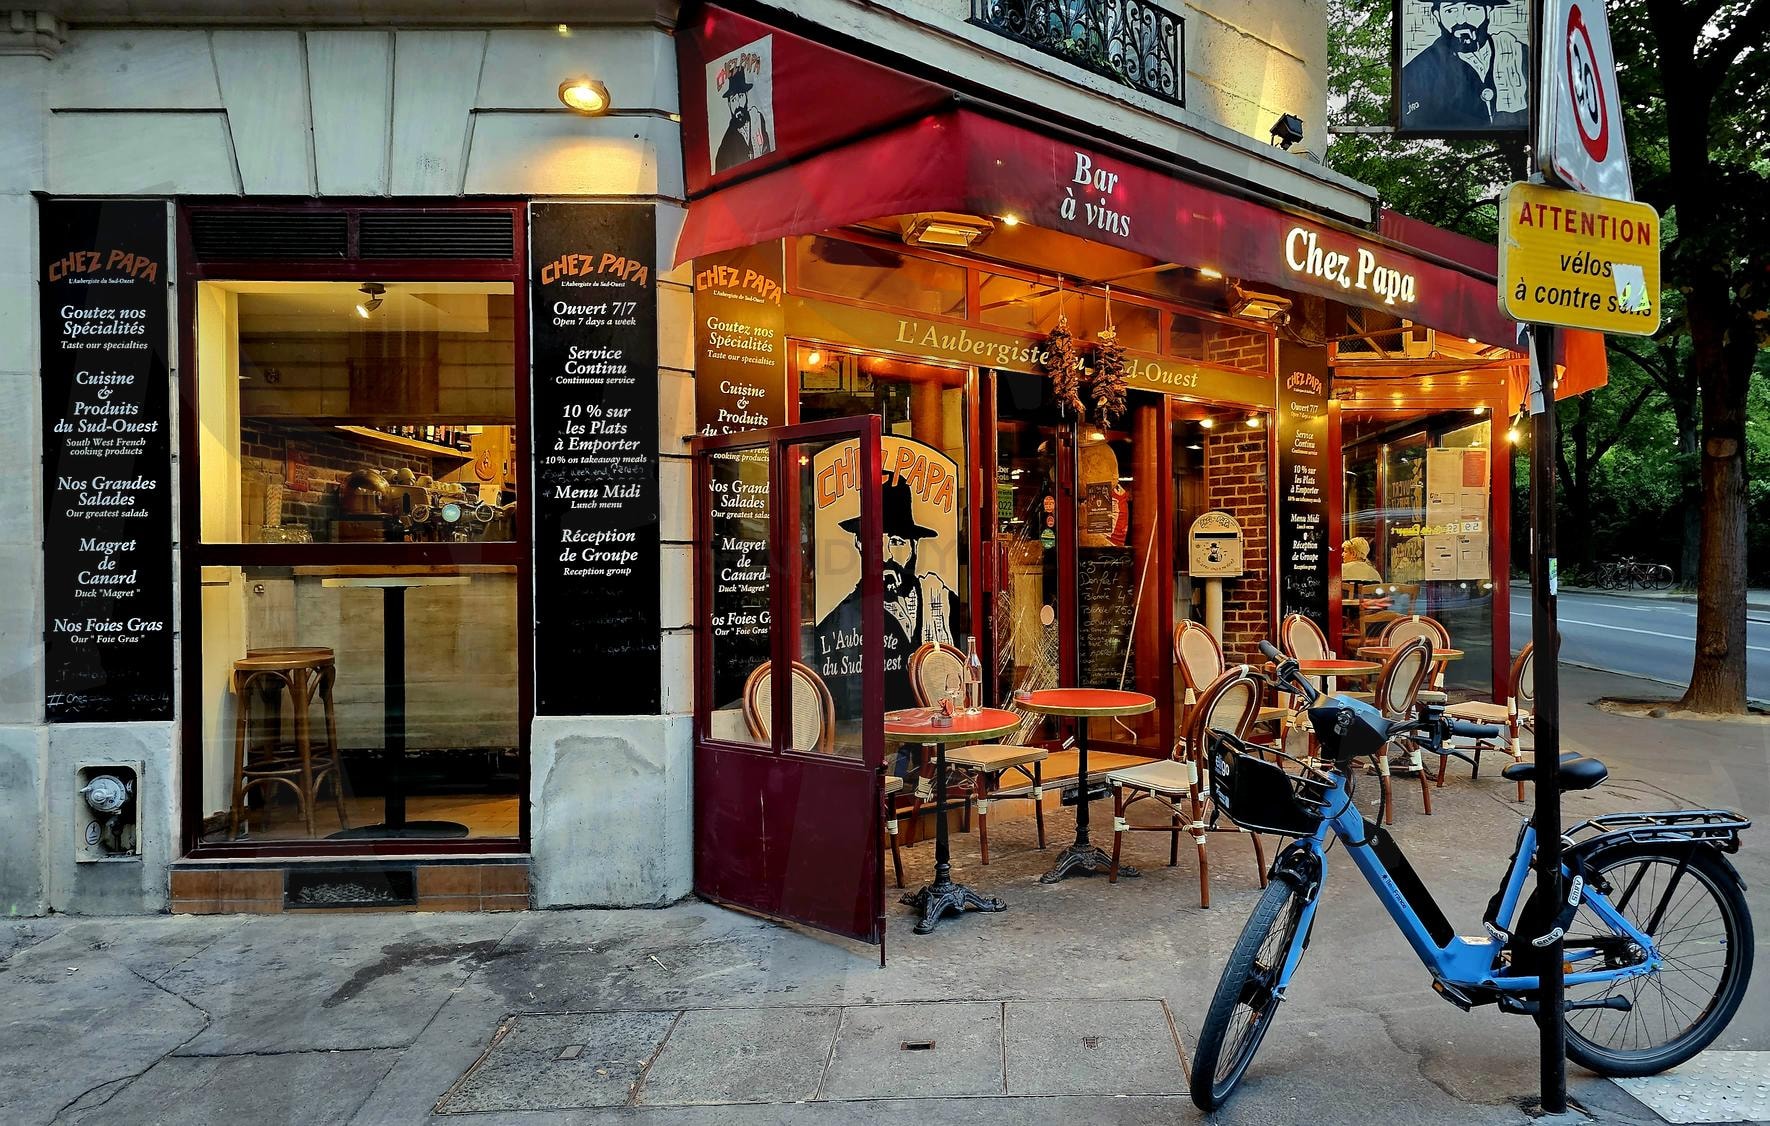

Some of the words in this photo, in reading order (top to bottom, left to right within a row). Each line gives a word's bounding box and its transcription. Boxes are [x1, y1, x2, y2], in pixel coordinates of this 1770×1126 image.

[1073, 151, 1119, 194] Bar
[1060, 186, 1076, 221] à
[1085, 198, 1130, 238] vins
[1519, 202, 1651, 246] ATTENTION
[48, 251, 102, 283] CHEZ
[106, 250, 158, 283] PAPA
[541, 254, 594, 285] CHEZ
[598, 253, 648, 286] PAPA
[1286, 227, 1350, 289] Chez
[1356, 248, 1415, 304] Papa
[1560, 250, 1612, 278] vélos
[696, 265, 739, 291] CHEZ
[743, 269, 782, 305] PAPA
[1515, 276, 1526, 301] à
[1534, 285, 1600, 312] contre
[60, 305, 115, 320] Goutez
[120, 308, 146, 319] nos
[553, 301, 607, 315] Ouvert
[612, 302, 637, 316] 7/7
[63, 321, 145, 338] Spécialités
[553, 318, 576, 327] Open
[578, 318, 583, 326] 7
[586, 318, 605, 327] days
[615, 318, 636, 326] week
[707, 316, 750, 336] Goutez
[754, 326, 774, 338] nos
[61, 340, 84, 349] Taste
[103, 341, 148, 350] specialties
[710, 332, 773, 353] Spécialités
[896, 320, 1049, 366] L'Aubergiste
[568, 346, 622, 360] Service
[708, 350, 726, 360] Taste
[728, 354, 740, 362] our
[741, 354, 775, 366] specialties
[564, 361, 627, 374] Continu
[76, 370, 135, 385] Cuisine
[556, 376, 604, 384] Continuous
[606, 376, 635, 384] service
[1287, 372, 1304, 390] CHEZ
[1305, 373, 1322, 394] PAPA
[97, 386, 113, 400] &
[720, 381, 765, 398] Cuisine
[74, 401, 138, 416] Produits
[737, 396, 749, 409] &
[562, 404, 581, 418] 10
[586, 404, 602, 418] %
[606, 406, 631, 418] sur
[718, 409, 768, 426] Produits
[54, 418, 73, 433] du
[78, 418, 159, 433] Sud-Ouest
[566, 420, 585, 434] les
[590, 420, 628, 434] Plats
[66, 438, 90, 447] South
[93, 438, 115, 447] West
[116, 438, 146, 446] French
[554, 437, 564, 450] à
[568, 437, 640, 453] Emporter
[70, 447, 103, 456] cooking
[105, 448, 143, 456] products
[714, 453, 740, 462] cooking
[742, 454, 769, 462] products
[580, 456, 620, 465] takeaway
[58, 476, 87, 490] Nos
[92, 476, 156, 489] Grandes
[732, 480, 769, 494] Grand
[892, 447, 954, 513] PAPA
[78, 492, 135, 506] Salades
[554, 485, 598, 499] Menu
[603, 484, 640, 498] Midi
[571, 501, 597, 509] Lunch
[721, 494, 765, 509] Salades
[66, 509, 83, 517] Our
[85, 509, 119, 519] greatest
[121, 509, 148, 518] salads
[711, 510, 725, 518] Our
[726, 511, 753, 519] greatest
[1291, 514, 1306, 522] Menu
[561, 529, 636, 545] Réception
[79, 538, 136, 554] Magret
[722, 538, 766, 554] Magret
[98, 556, 116, 570] de
[559, 548, 576, 562] de
[581, 548, 638, 564] Groupe
[737, 554, 751, 567] de
[78, 570, 136, 584] Canard
[563, 568, 604, 577] Reception
[606, 568, 631, 576] group
[721, 568, 766, 581] Canard
[75, 589, 97, 597] Duck
[719, 585, 736, 593] Duck
[53, 619, 82, 632] Nos
[85, 618, 123, 632] Foies
[127, 618, 163, 632] Gras
[711, 613, 724, 626] os
[727, 612, 756, 625] Foies
[71, 635, 88, 643] Our
[715, 628, 729, 636] Our
[820, 628, 898, 654] L'Aubeste
[823, 657, 838, 676] du
[841, 654, 902, 675] Sudest
